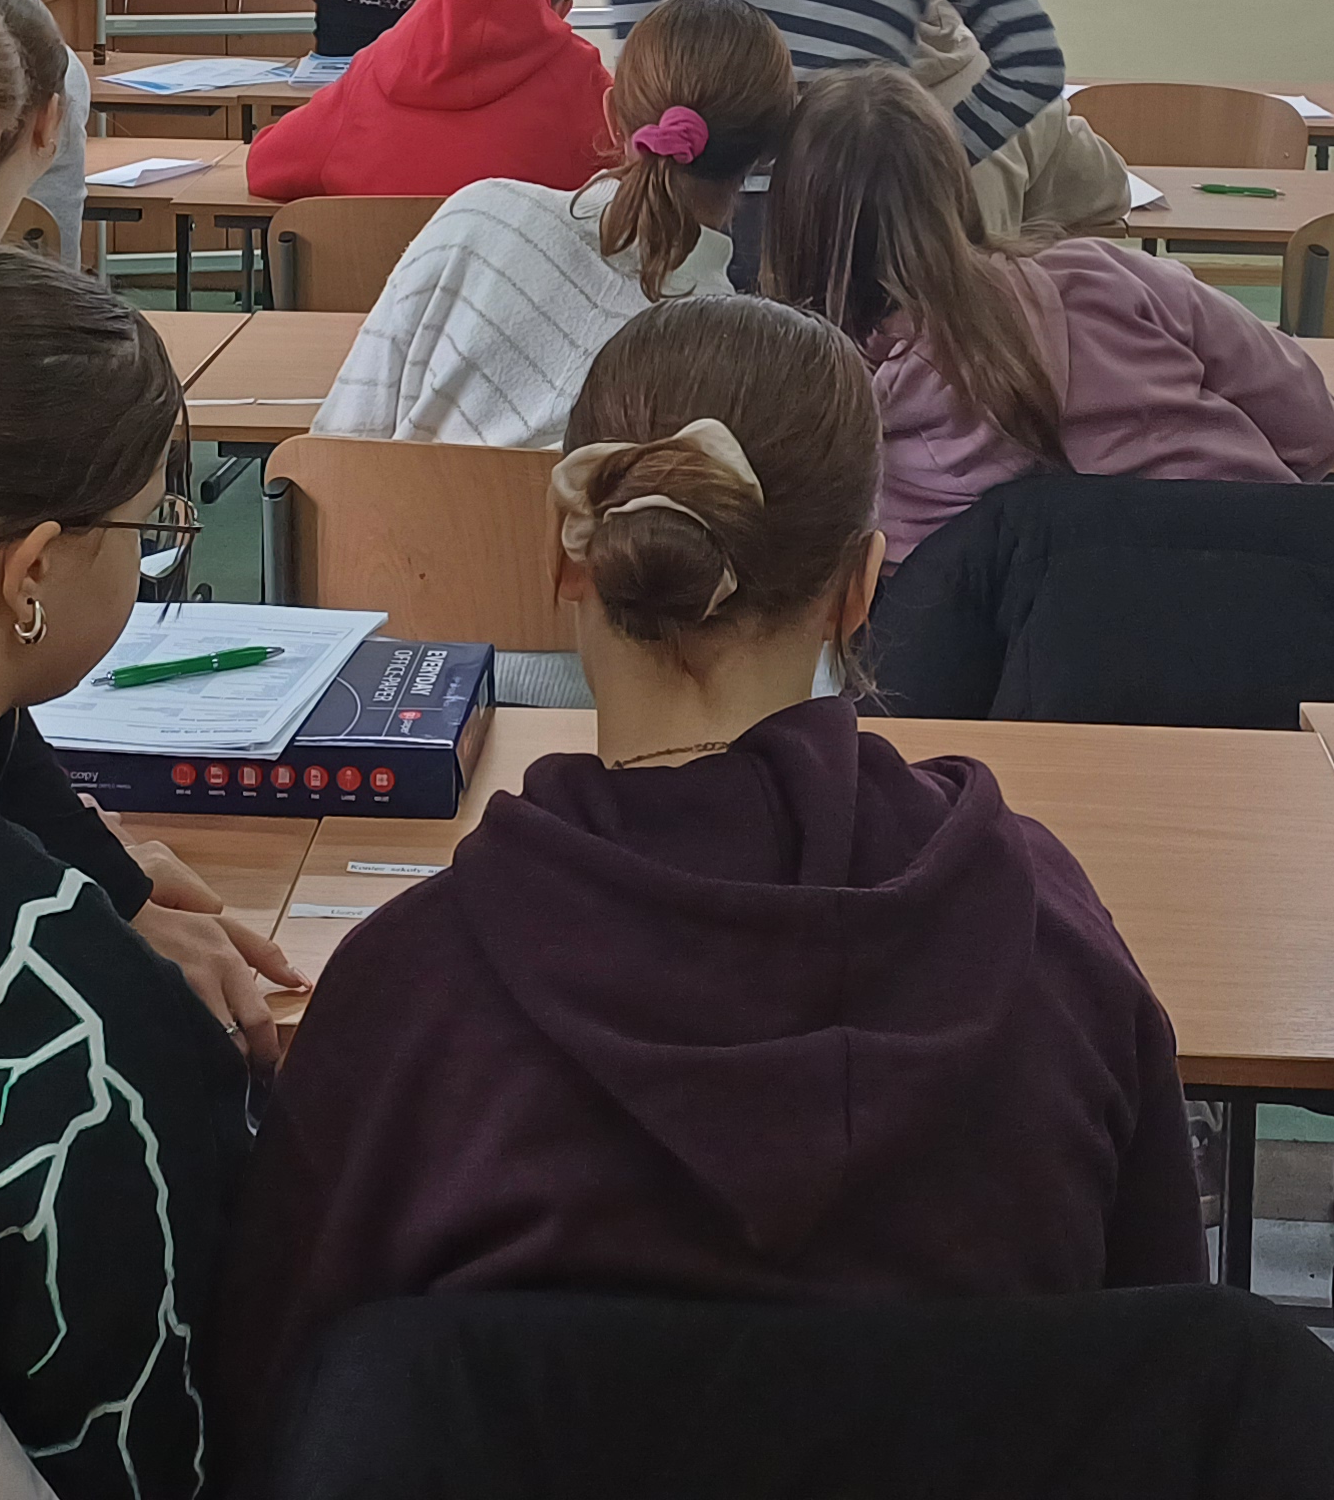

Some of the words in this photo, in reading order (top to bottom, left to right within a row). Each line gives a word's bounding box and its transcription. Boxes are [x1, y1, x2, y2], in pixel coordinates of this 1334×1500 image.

[372, 650, 413, 702] OFFICE-PAPER
[410, 651, 448, 696] EVERYDAY
[70, 771, 98, 782] copy
